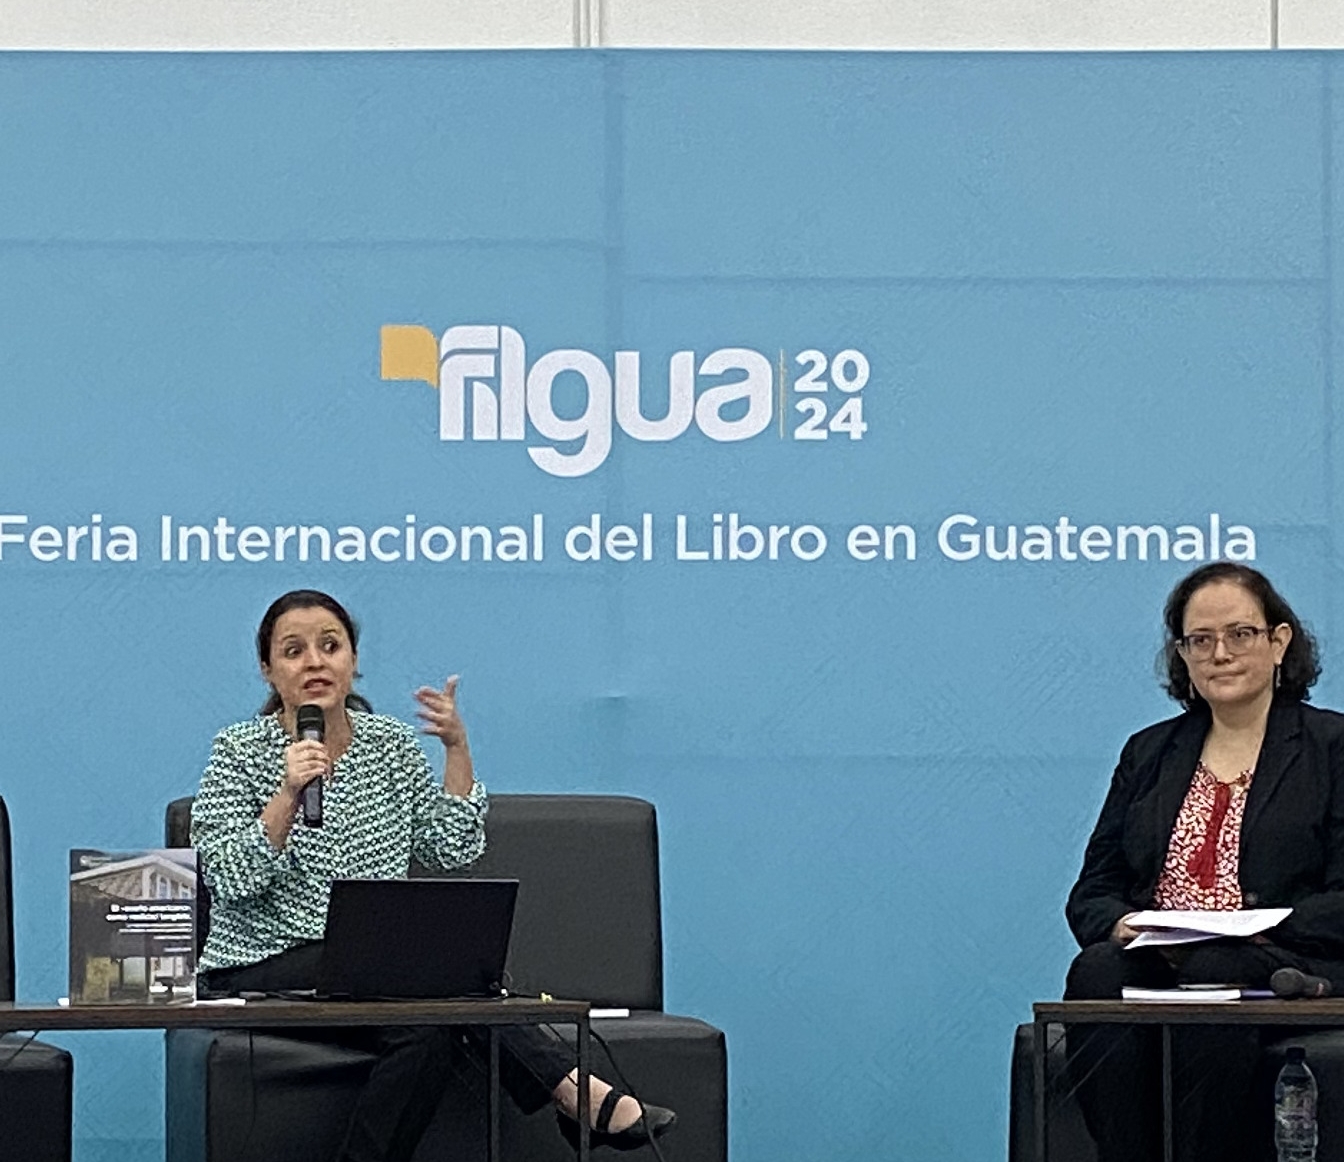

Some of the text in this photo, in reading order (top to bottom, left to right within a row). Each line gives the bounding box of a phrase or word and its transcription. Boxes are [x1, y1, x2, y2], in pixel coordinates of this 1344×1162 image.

[793, 349, 871, 393] 20
[438, 325, 774, 477] filgua
[793, 397, 869, 440] 24
[160, 513, 544, 563] Internacional
[564, 513, 654, 563] del
[676, 513, 828, 562] Libro
[846, 524, 917, 562] en
[937, 513, 1257, 562] Guatemala
